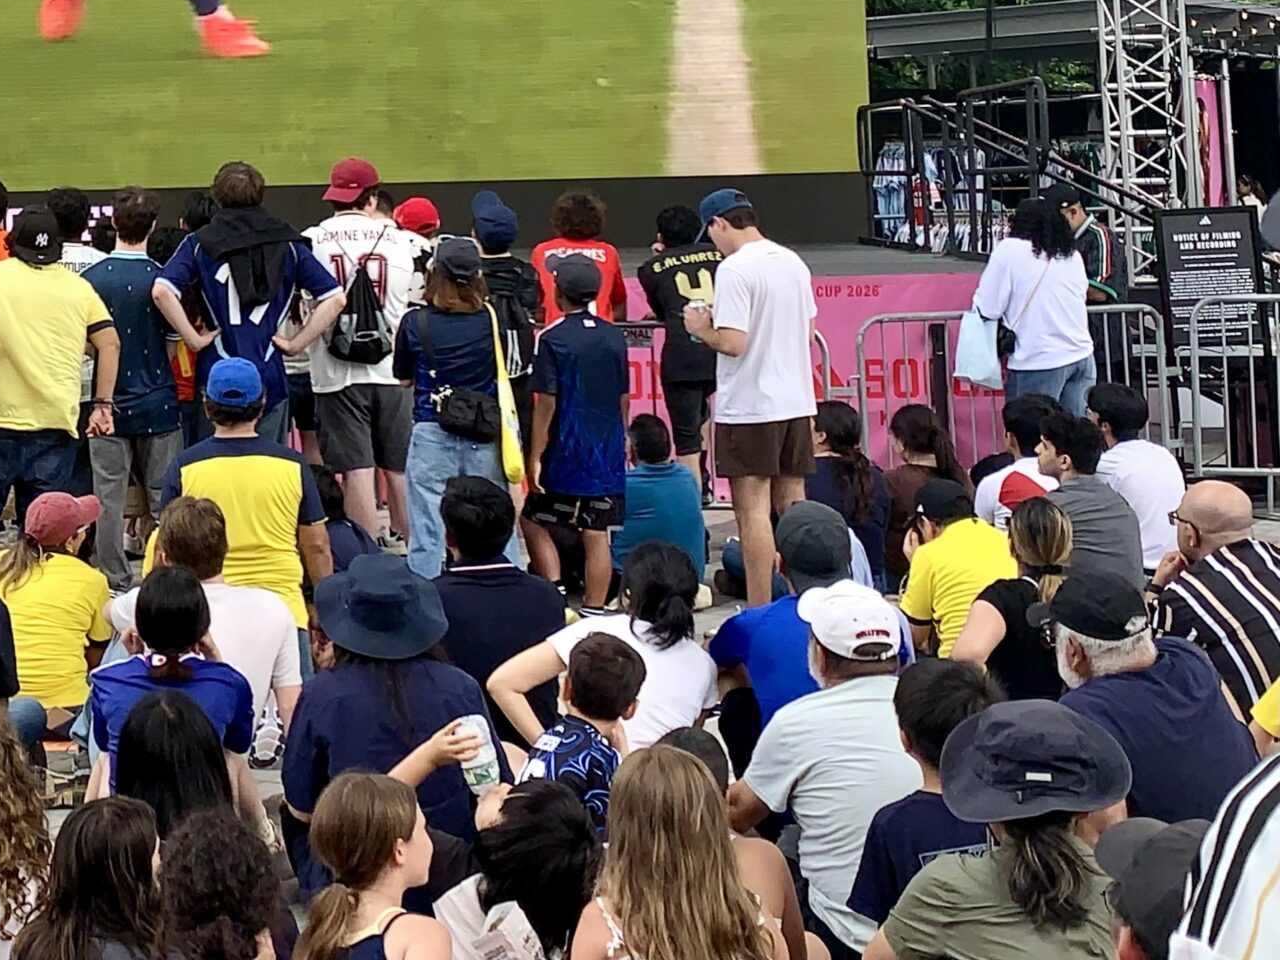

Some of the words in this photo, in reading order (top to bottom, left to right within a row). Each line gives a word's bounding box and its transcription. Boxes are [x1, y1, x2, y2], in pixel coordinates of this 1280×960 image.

[1172, 233, 1199, 242] NOTICE
[1211, 231, 1242, 240] FILMING
[1179, 242, 1194, 250] AND
[1196, 240, 1237, 250] RECORDING
[816, 285, 842, 298] CUP
